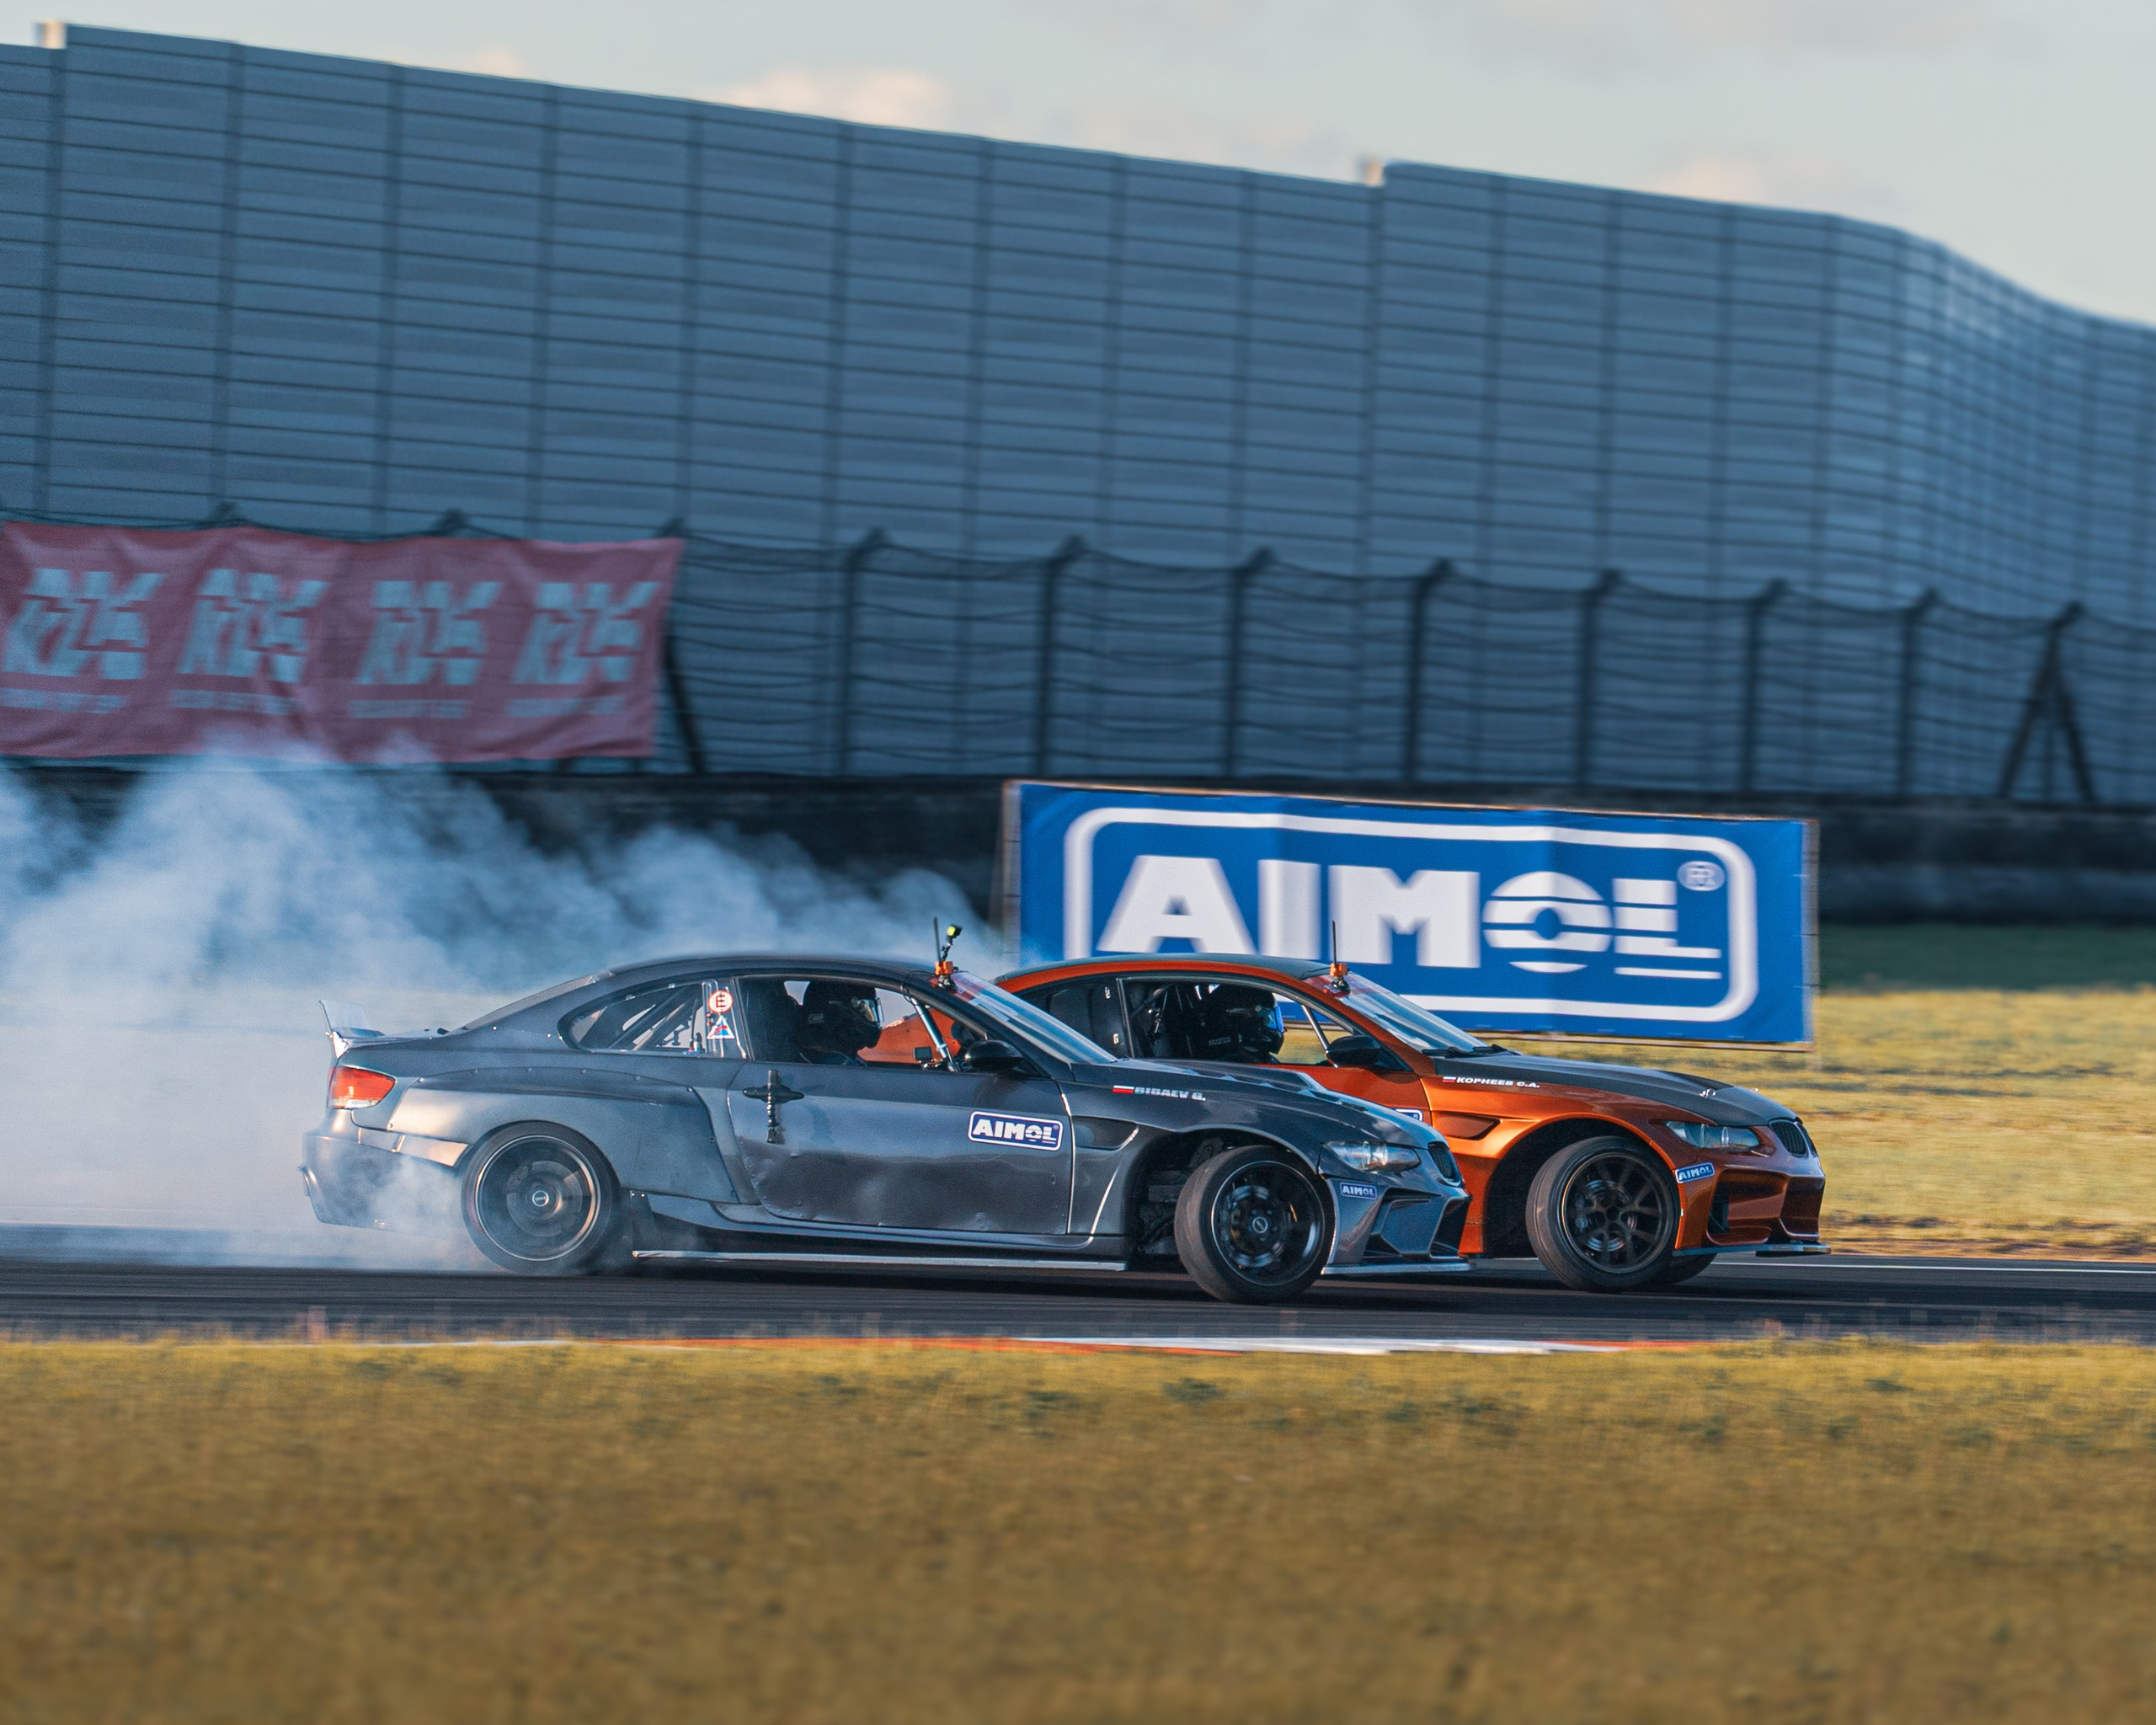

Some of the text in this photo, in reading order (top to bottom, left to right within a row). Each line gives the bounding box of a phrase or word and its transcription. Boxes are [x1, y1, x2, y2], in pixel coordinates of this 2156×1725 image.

[1096, 854, 1722, 980] AIMOL
[716, 995, 726, 1008] E
[972, 1119, 1057, 1145] AIMOL
[1678, 1166, 1713, 1181] AIMOL
[1342, 1185, 1375, 1196] AIMOL
